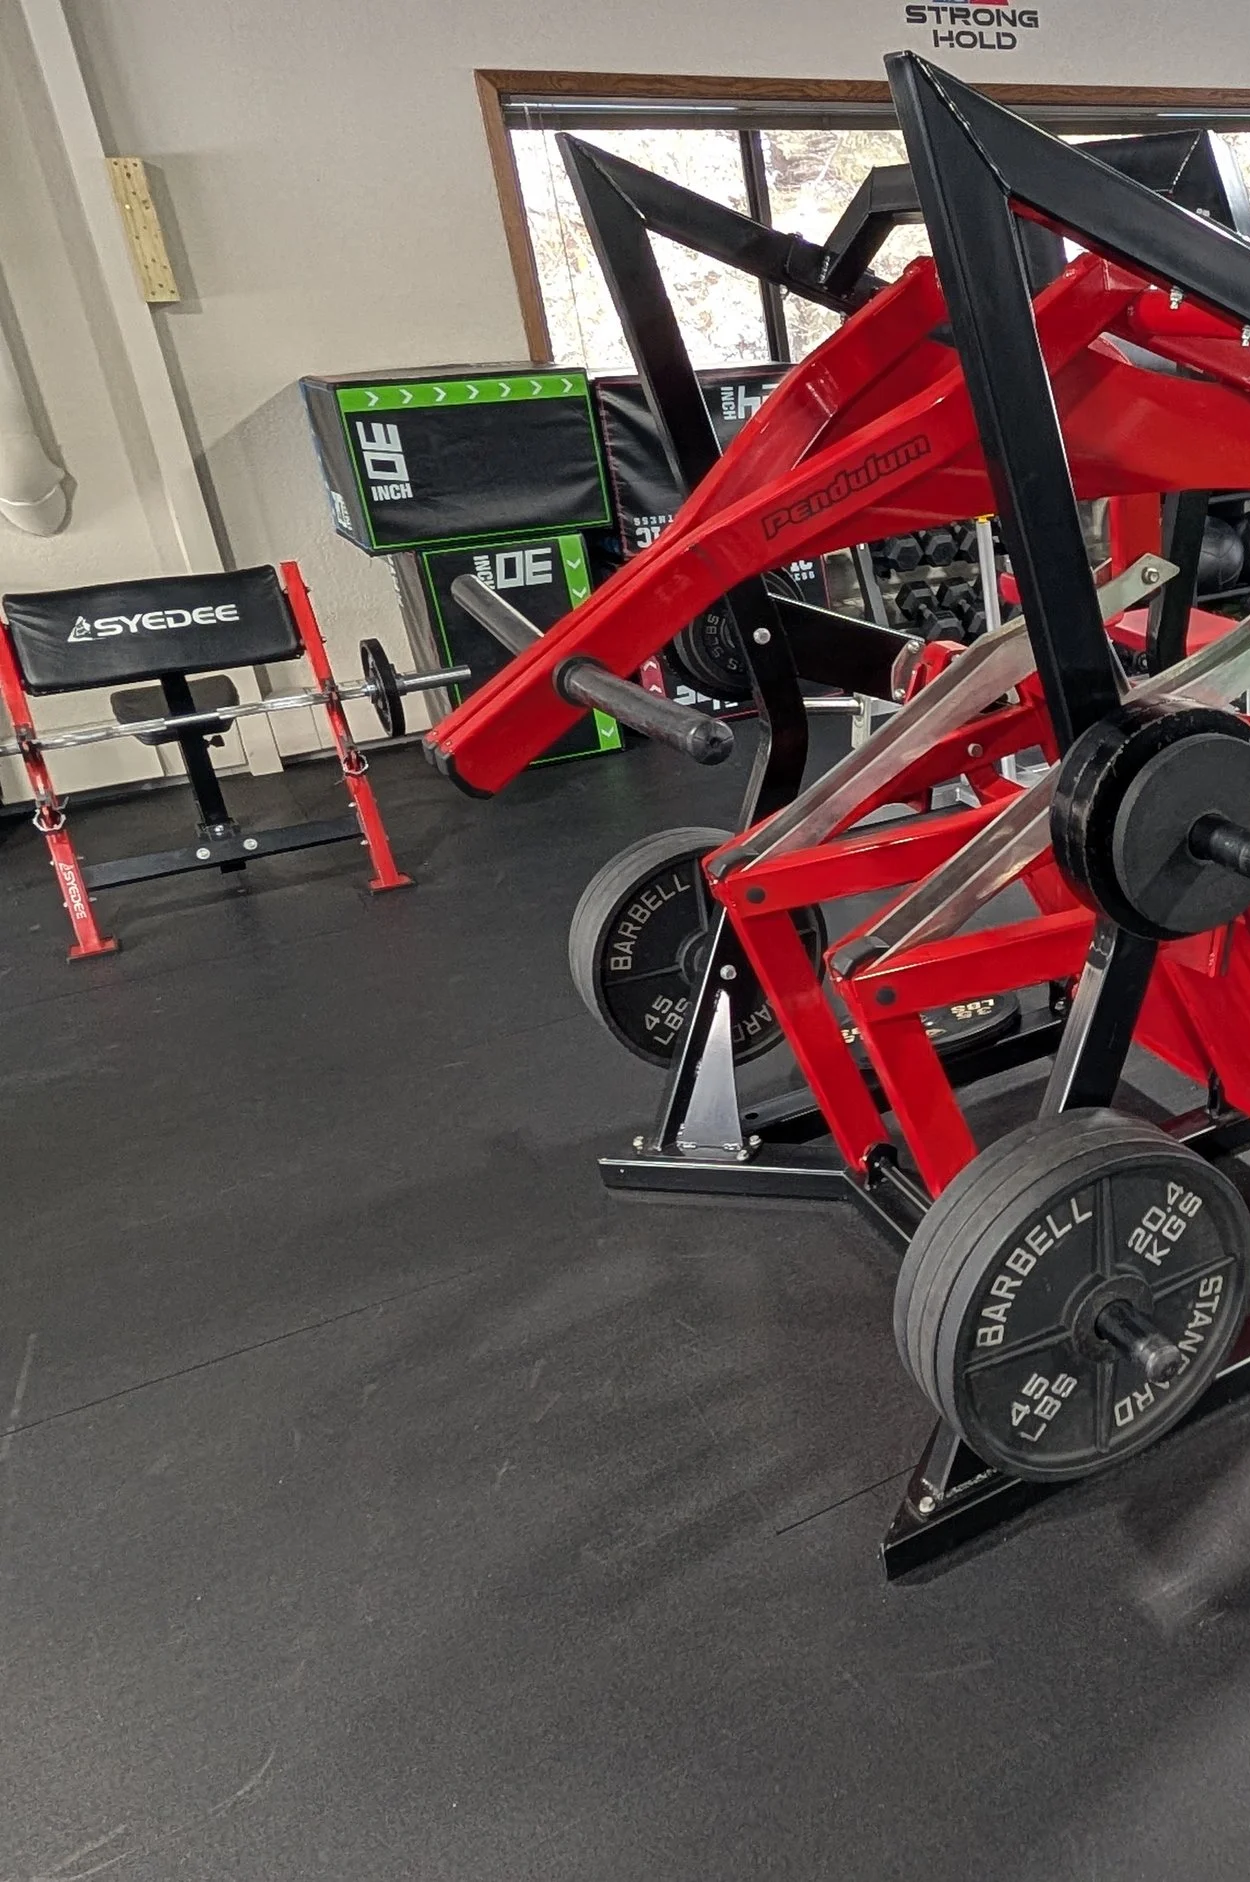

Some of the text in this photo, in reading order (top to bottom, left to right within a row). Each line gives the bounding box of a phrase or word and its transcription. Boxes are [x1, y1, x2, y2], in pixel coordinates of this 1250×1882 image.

[905, 5, 1039, 28] STRONG
[932, 30, 1017, 50] HOLD
[720, 386, 737, 421] INCH
[371, 483, 413, 502] INCH
[761, 434, 932, 541] Pendulum
[93, 603, 240, 638] SYEDEE
[63, 870, 87, 920] SYEDEE
[610, 874, 690, 971] BARBELL
[644, 995, 674, 1031] 45
[653, 997, 692, 1046] LBS
[1127, 1181, 1184, 1255] 20.4
[1144, 1191, 1203, 1266] KGS
[976, 1197, 1093, 1348] BARBELL
[1010, 1373, 1050, 1427] 45
[1020, 1373, 1078, 1442] LBS
